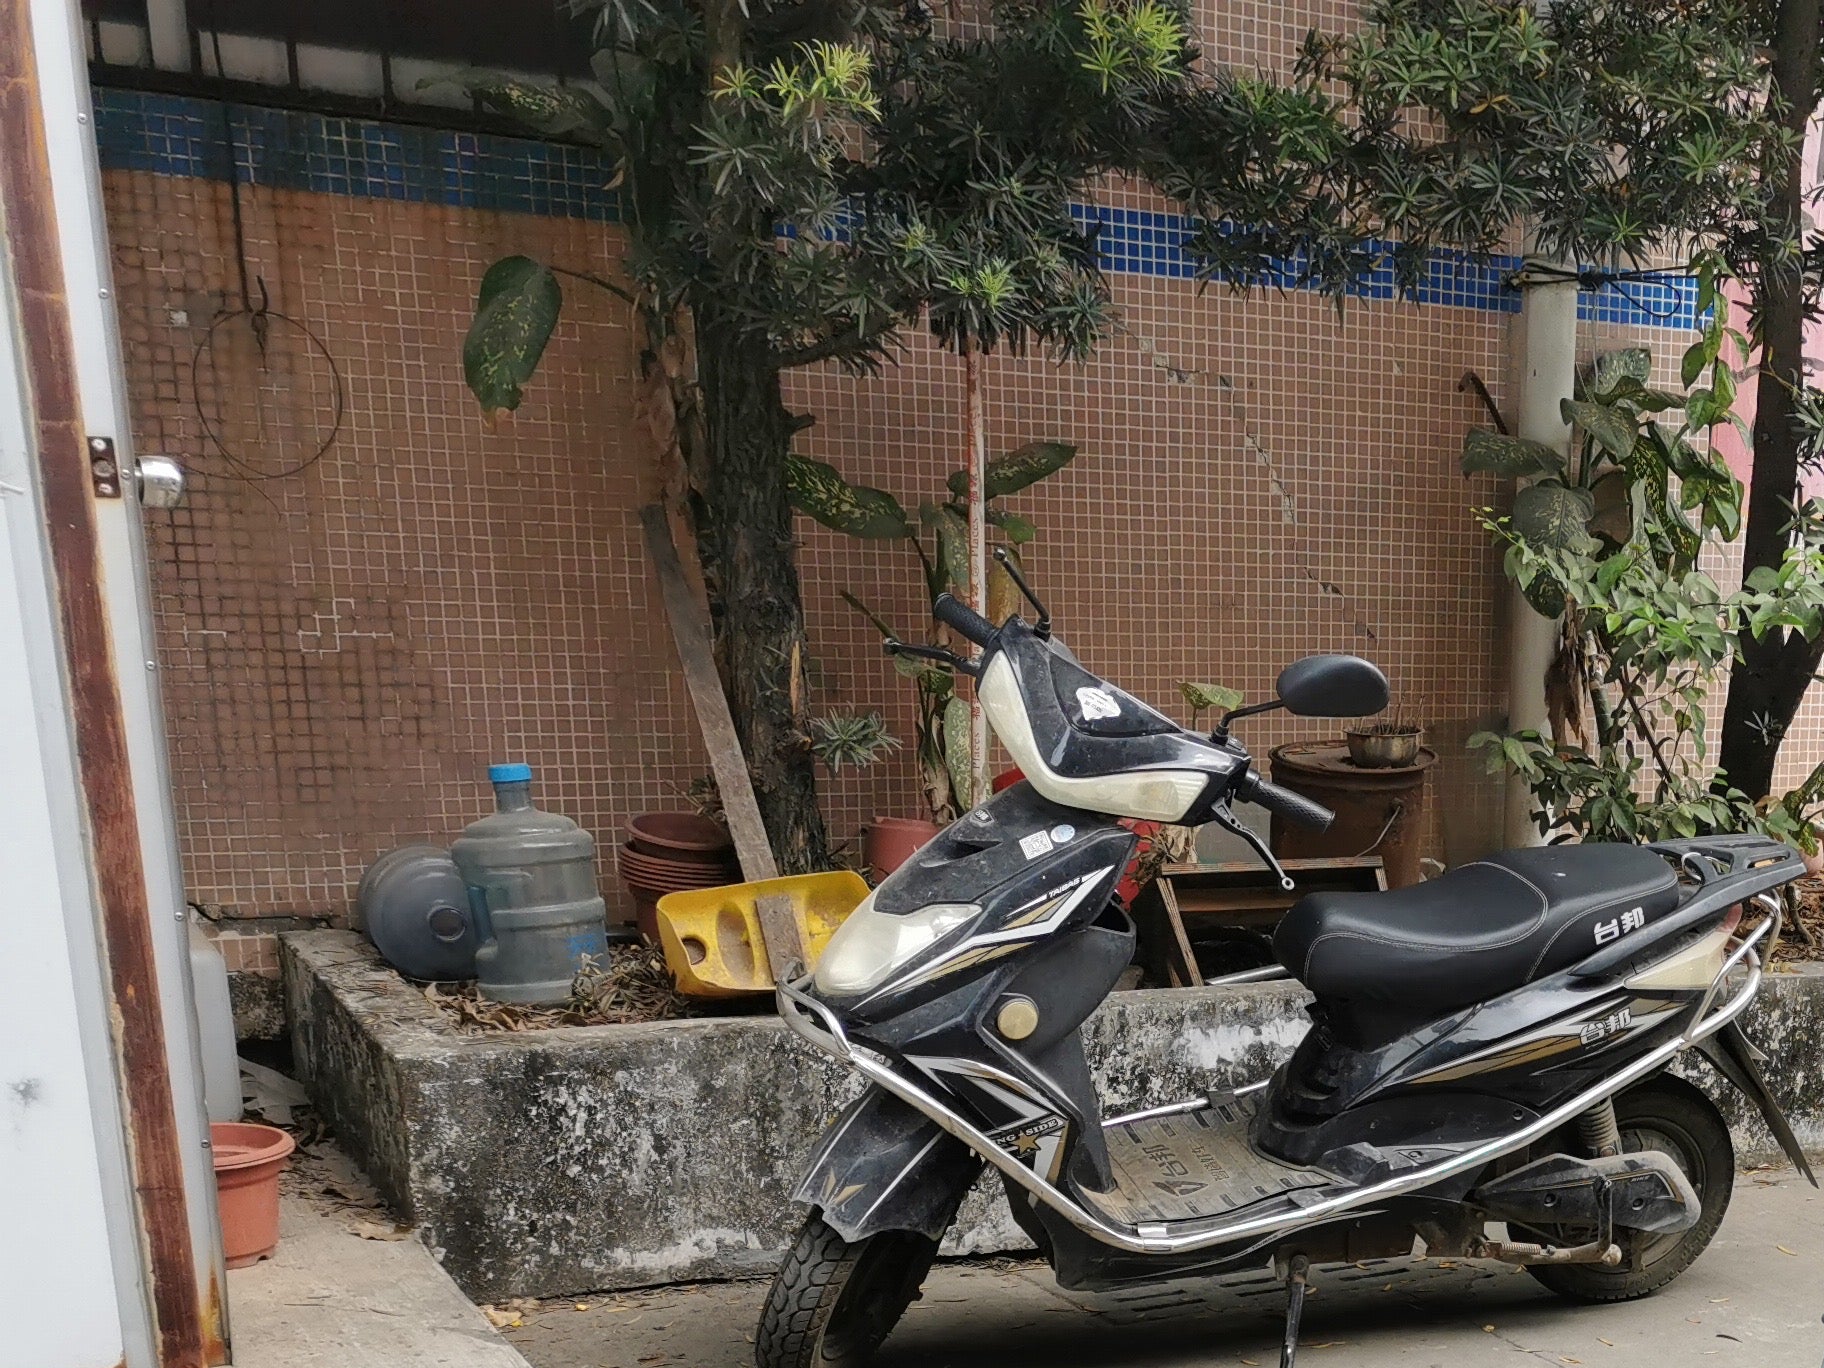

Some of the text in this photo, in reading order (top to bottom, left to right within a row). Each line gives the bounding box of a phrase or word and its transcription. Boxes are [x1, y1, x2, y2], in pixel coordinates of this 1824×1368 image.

[1593, 906, 1645, 946] 台邦
[1579, 1007, 1632, 1045] 台邦
[1025, 1118, 1059, 1136] SIDE
